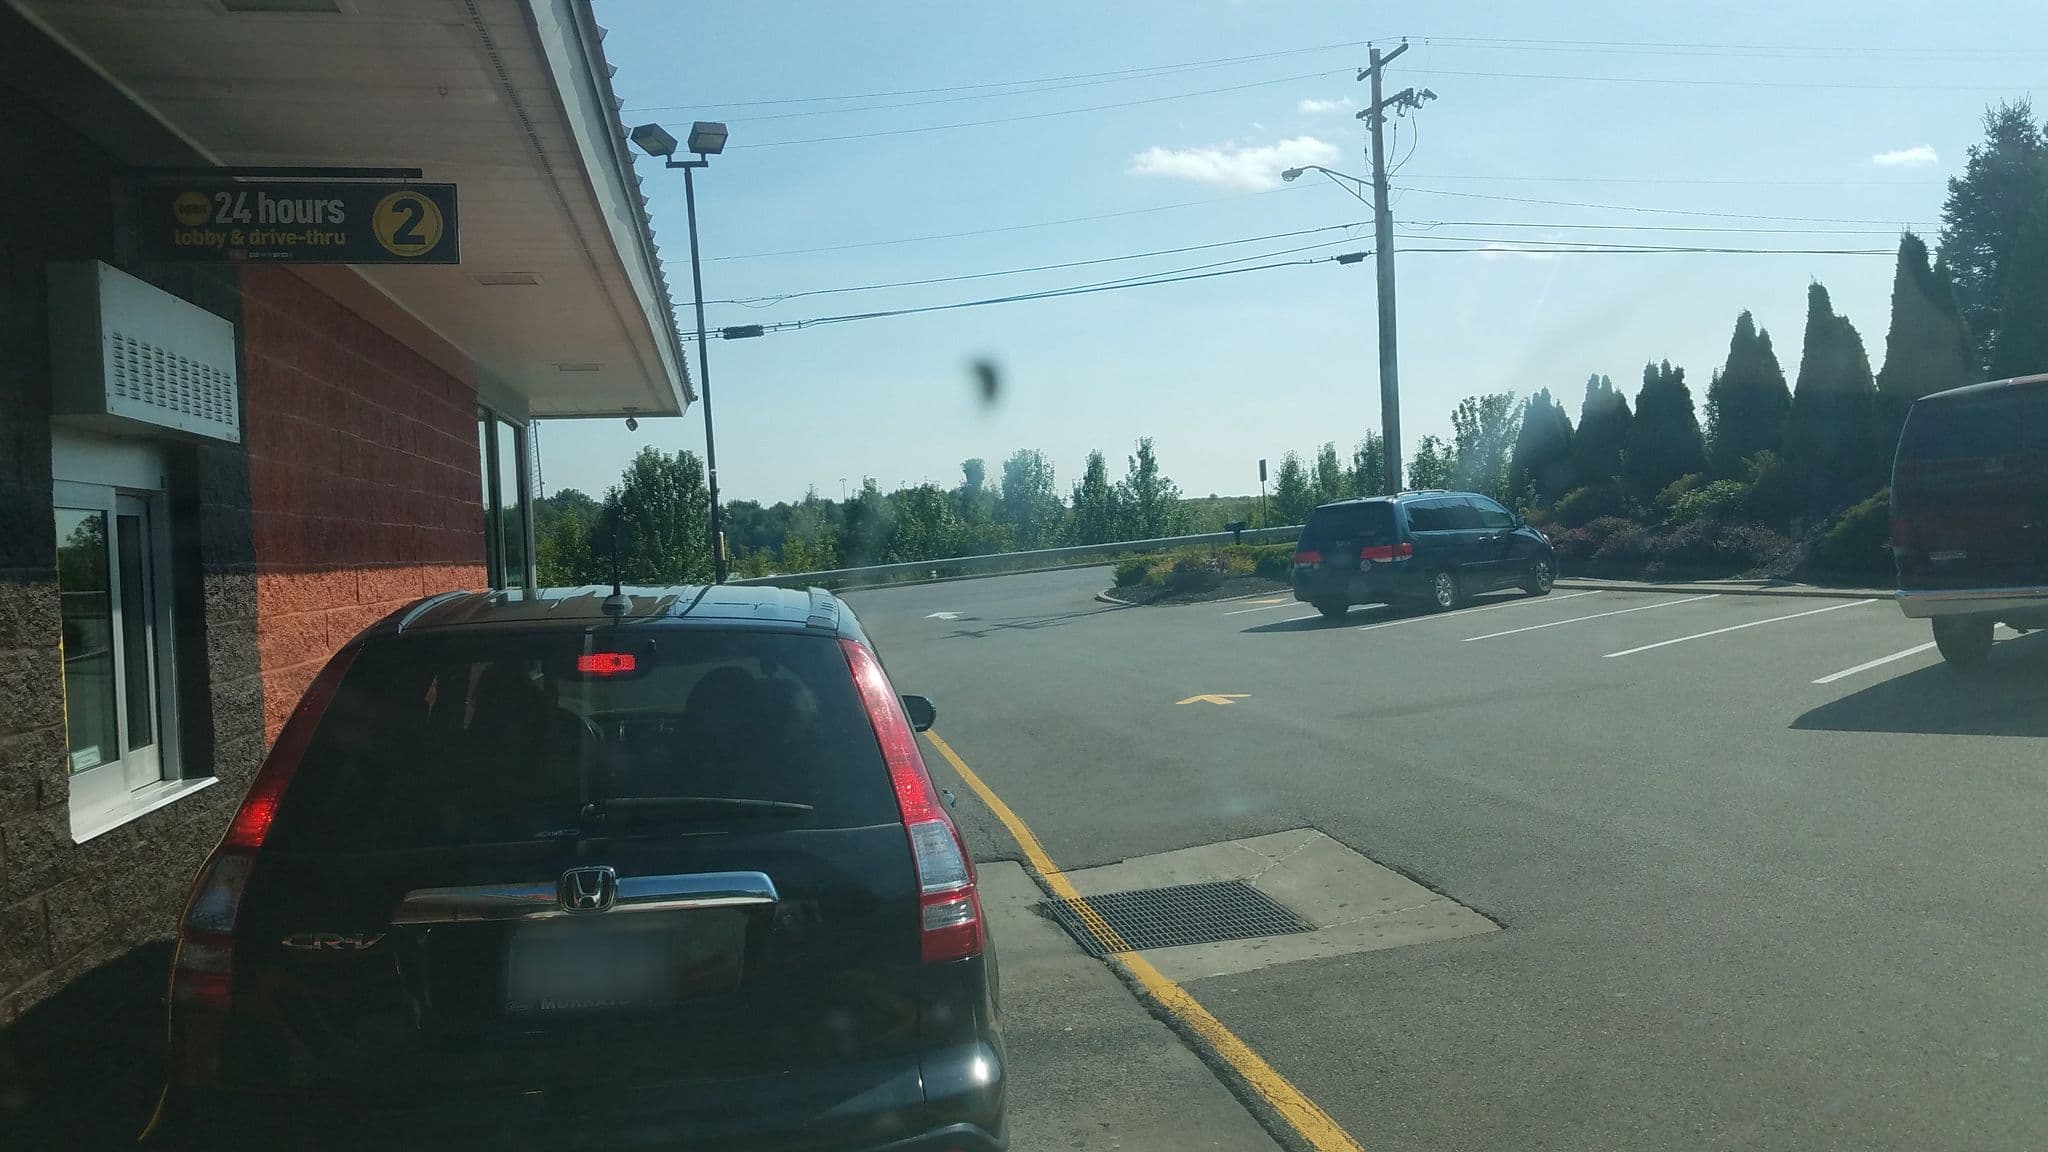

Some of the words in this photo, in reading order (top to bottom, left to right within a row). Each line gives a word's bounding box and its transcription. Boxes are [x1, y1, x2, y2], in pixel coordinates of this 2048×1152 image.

[214, 191, 253, 224] 24
[257, 191, 345, 224] hours
[392, 198, 426, 245] 2
[174, 229, 226, 249] lobby
[230, 229, 245, 246] &
[249, 227, 347, 247] drive-thru
[281, 930, 387, 951] CR-V
